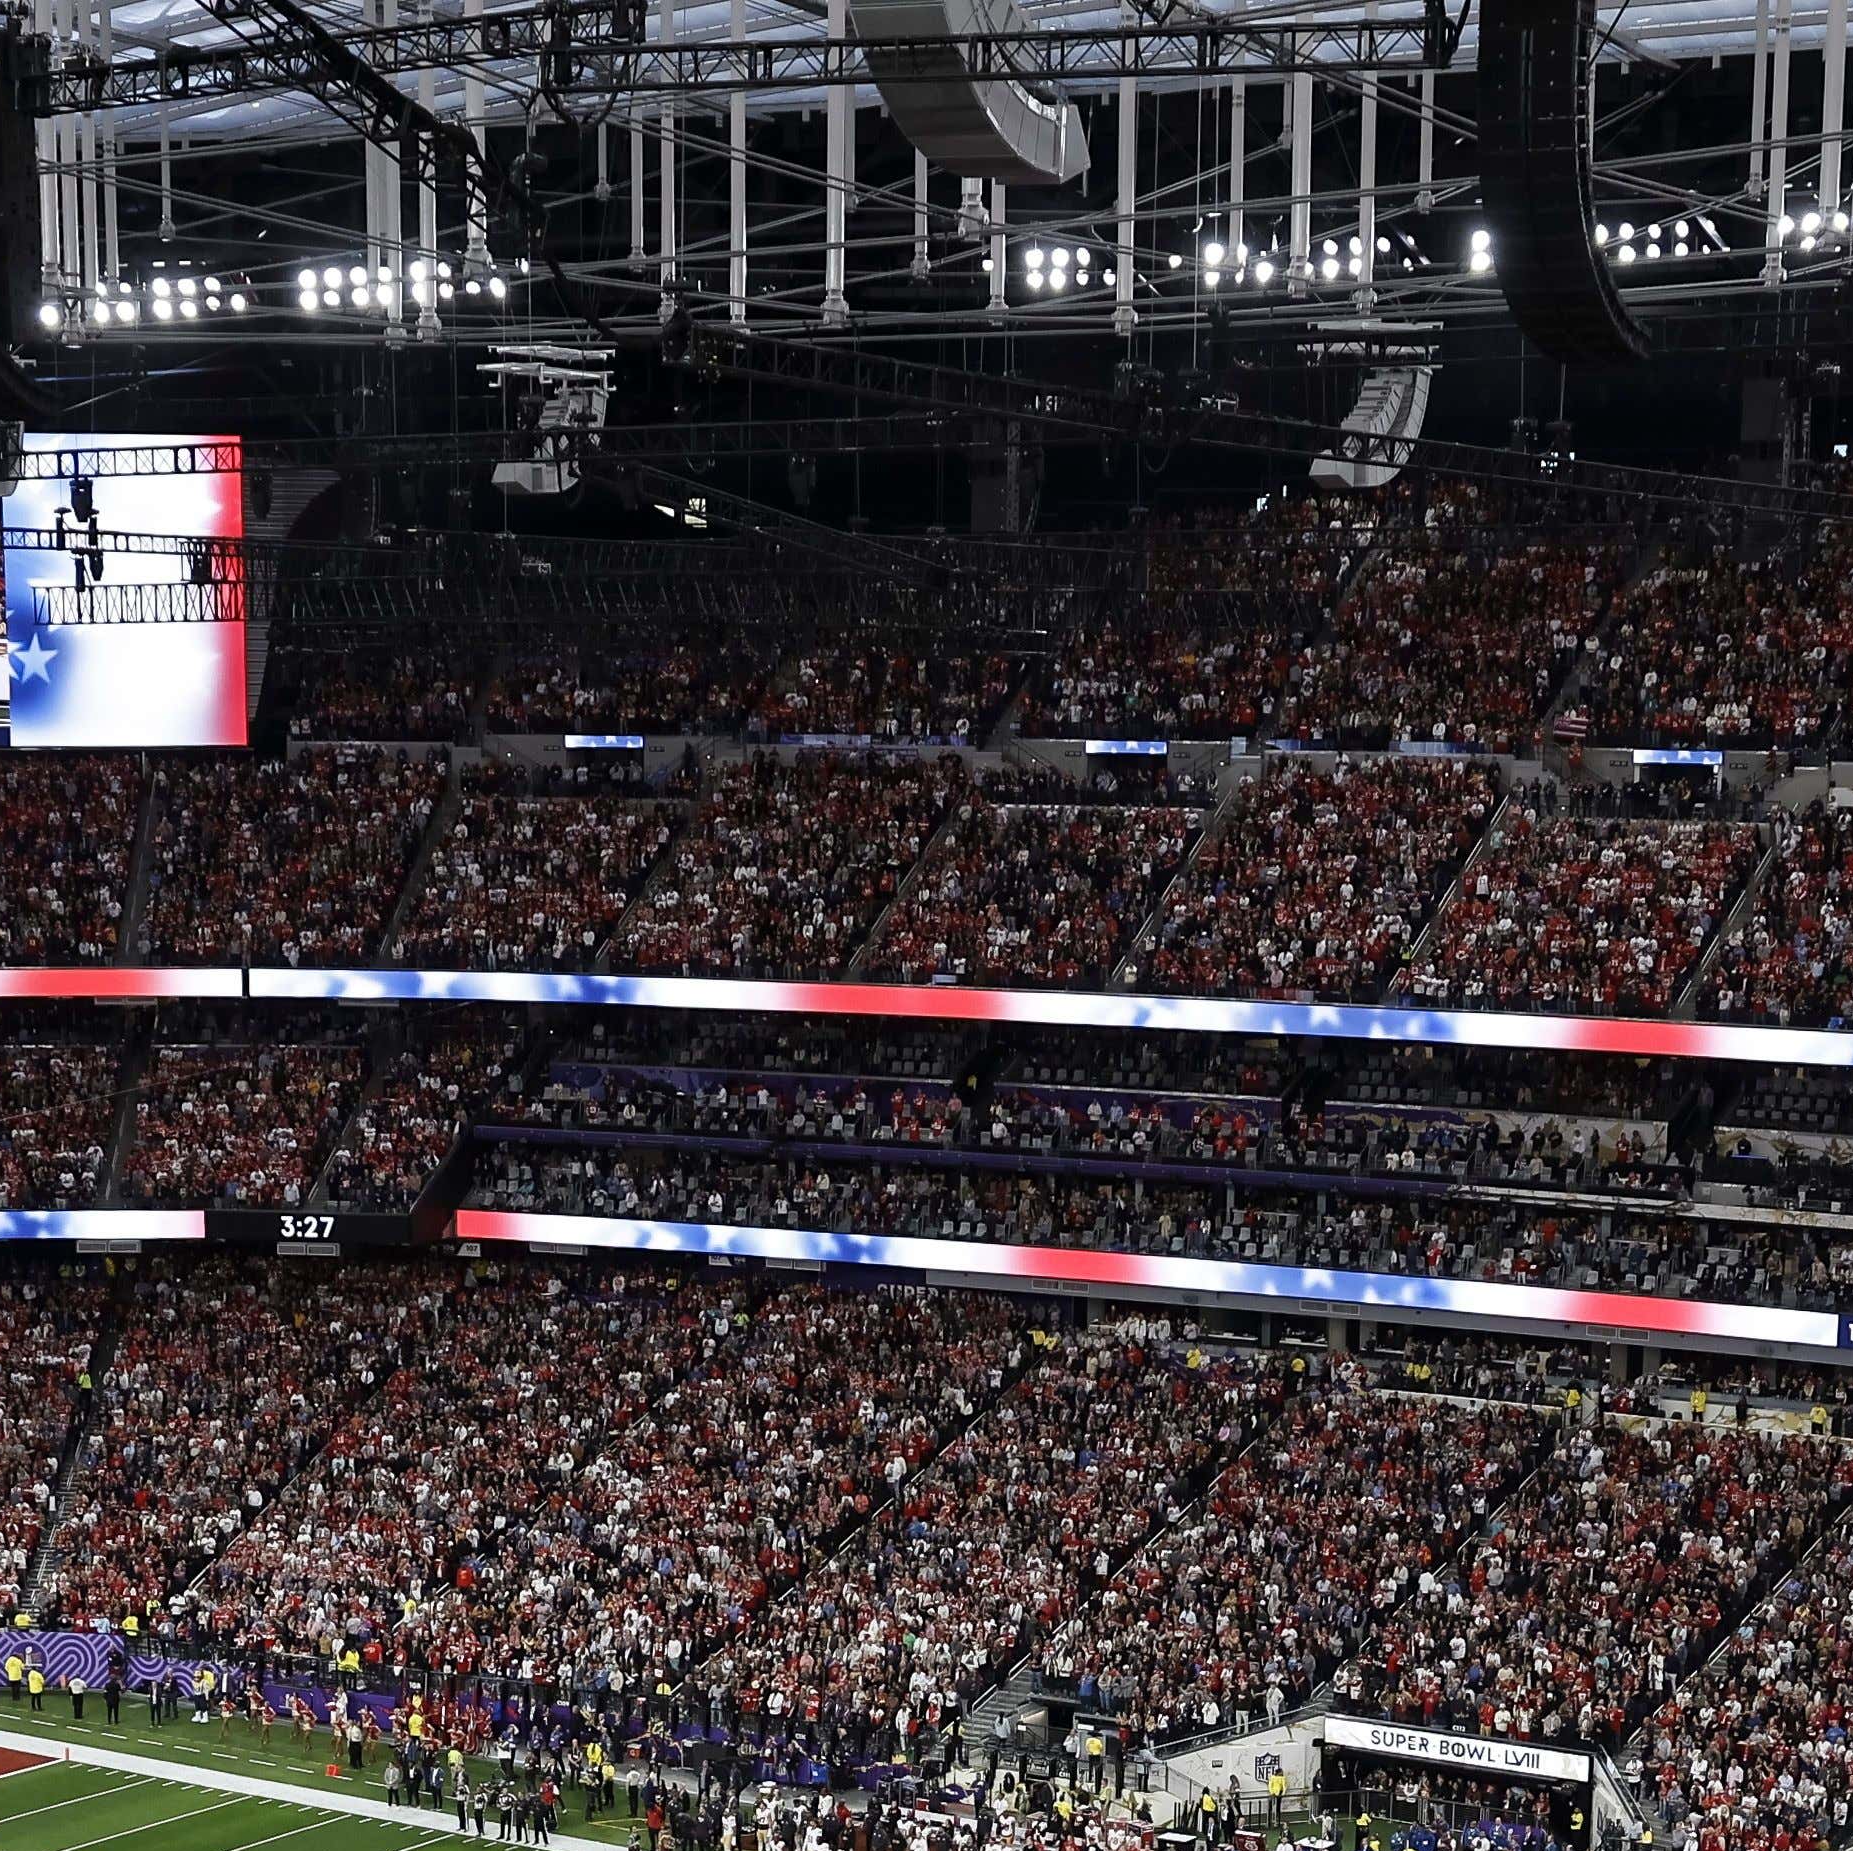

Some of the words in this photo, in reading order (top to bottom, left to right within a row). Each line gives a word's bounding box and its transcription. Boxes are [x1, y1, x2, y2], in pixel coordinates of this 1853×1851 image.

[280, 1214, 335, 1238] 3:27
[1371, 1730, 1430, 1753] SUPER
[1439, 1741, 1496, 1764] BOWL
[1505, 1750, 1540, 1770] LVIII
